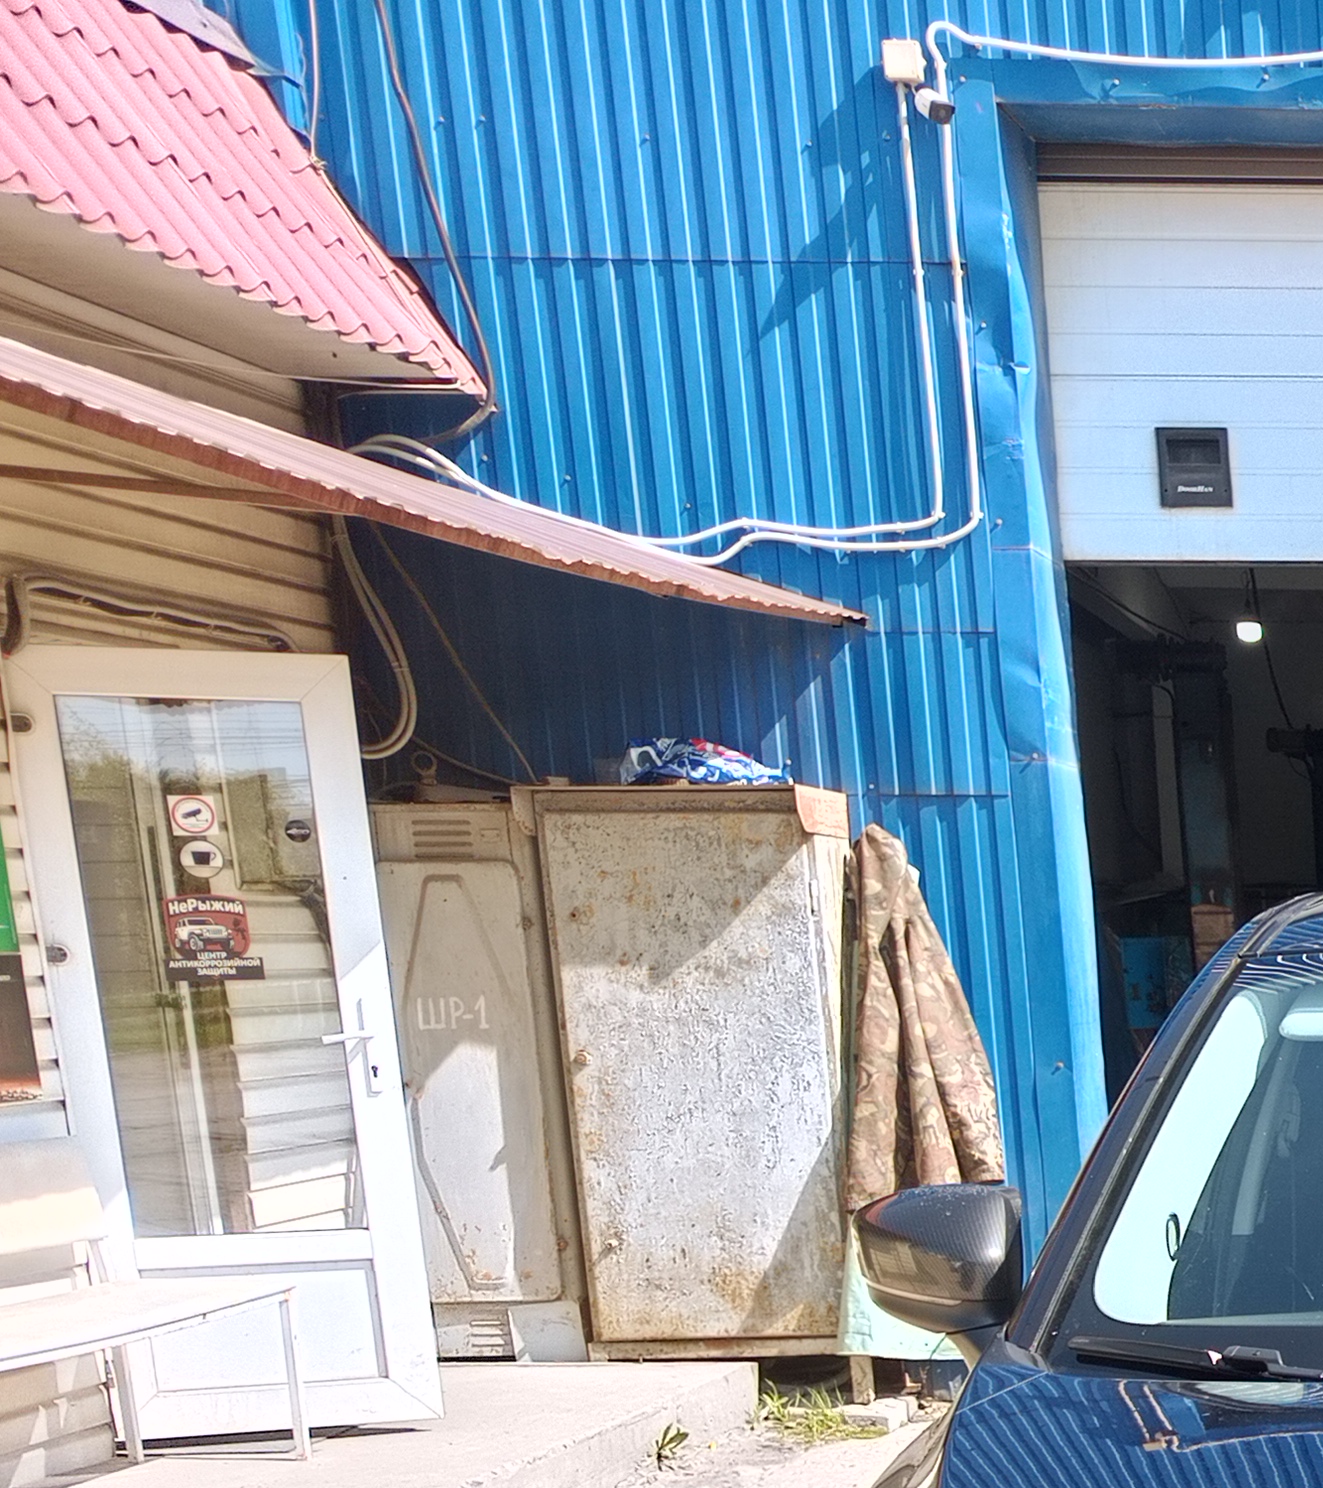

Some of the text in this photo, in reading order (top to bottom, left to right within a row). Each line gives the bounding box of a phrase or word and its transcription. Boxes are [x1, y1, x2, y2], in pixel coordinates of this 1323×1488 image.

[168, 898, 244, 915] НеРыжий
[197, 951, 227, 960] ЦЕНТР
[169, 957, 261, 968] АНТИКОРРОЗИЙНОЙ
[197, 967, 237, 976] ЗАЩИТЫ
[417, 994, 490, 1030] ШР-1
